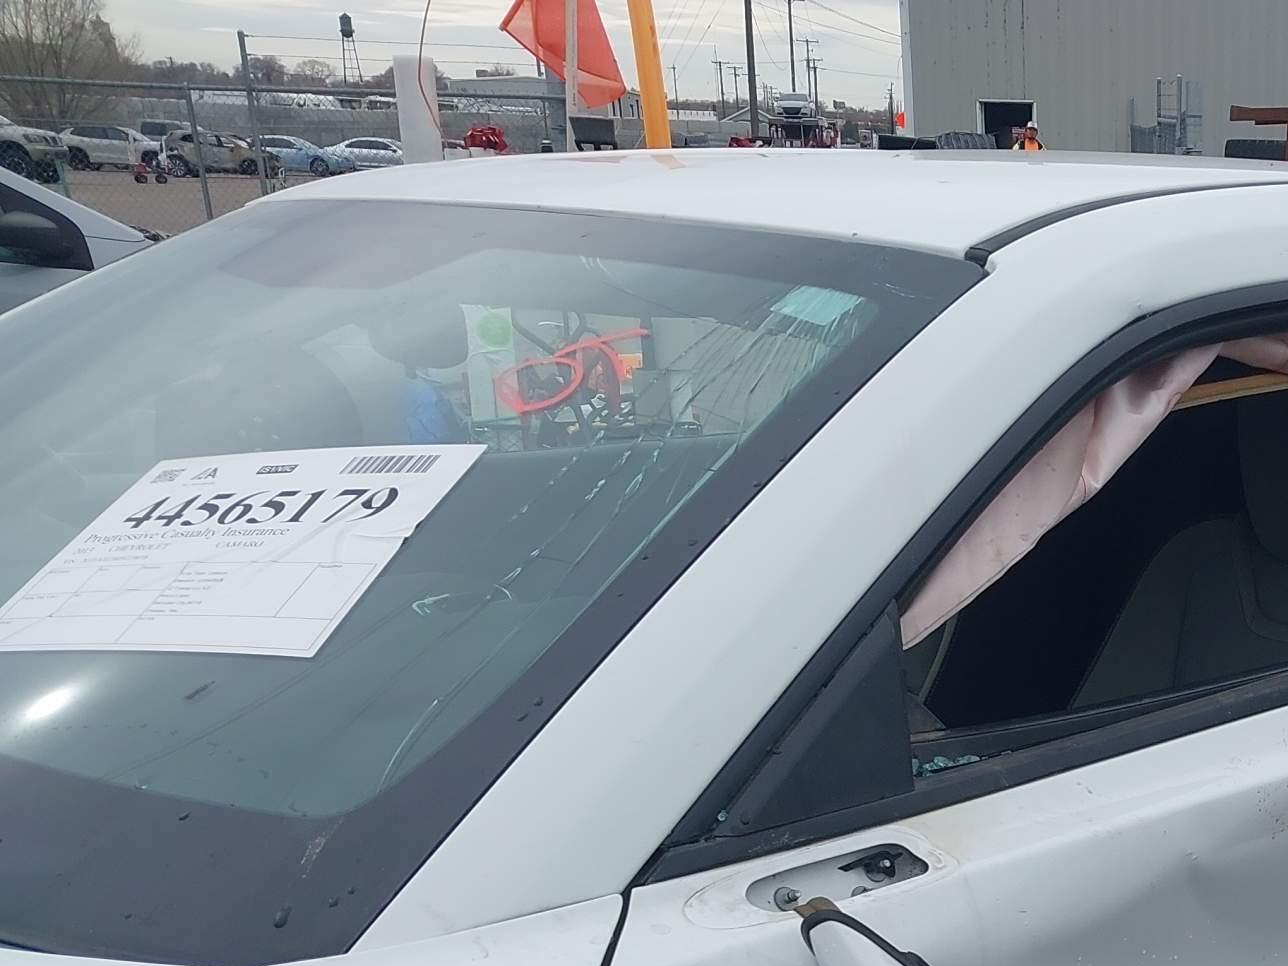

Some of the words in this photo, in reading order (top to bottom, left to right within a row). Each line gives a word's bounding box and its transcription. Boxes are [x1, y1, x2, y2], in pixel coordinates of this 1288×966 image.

[122, 487, 399, 529] 44565179
[84, 531, 160, 545] Progressive
[161, 529, 217, 540] Casualty
[221, 527, 290, 537] Insurance
